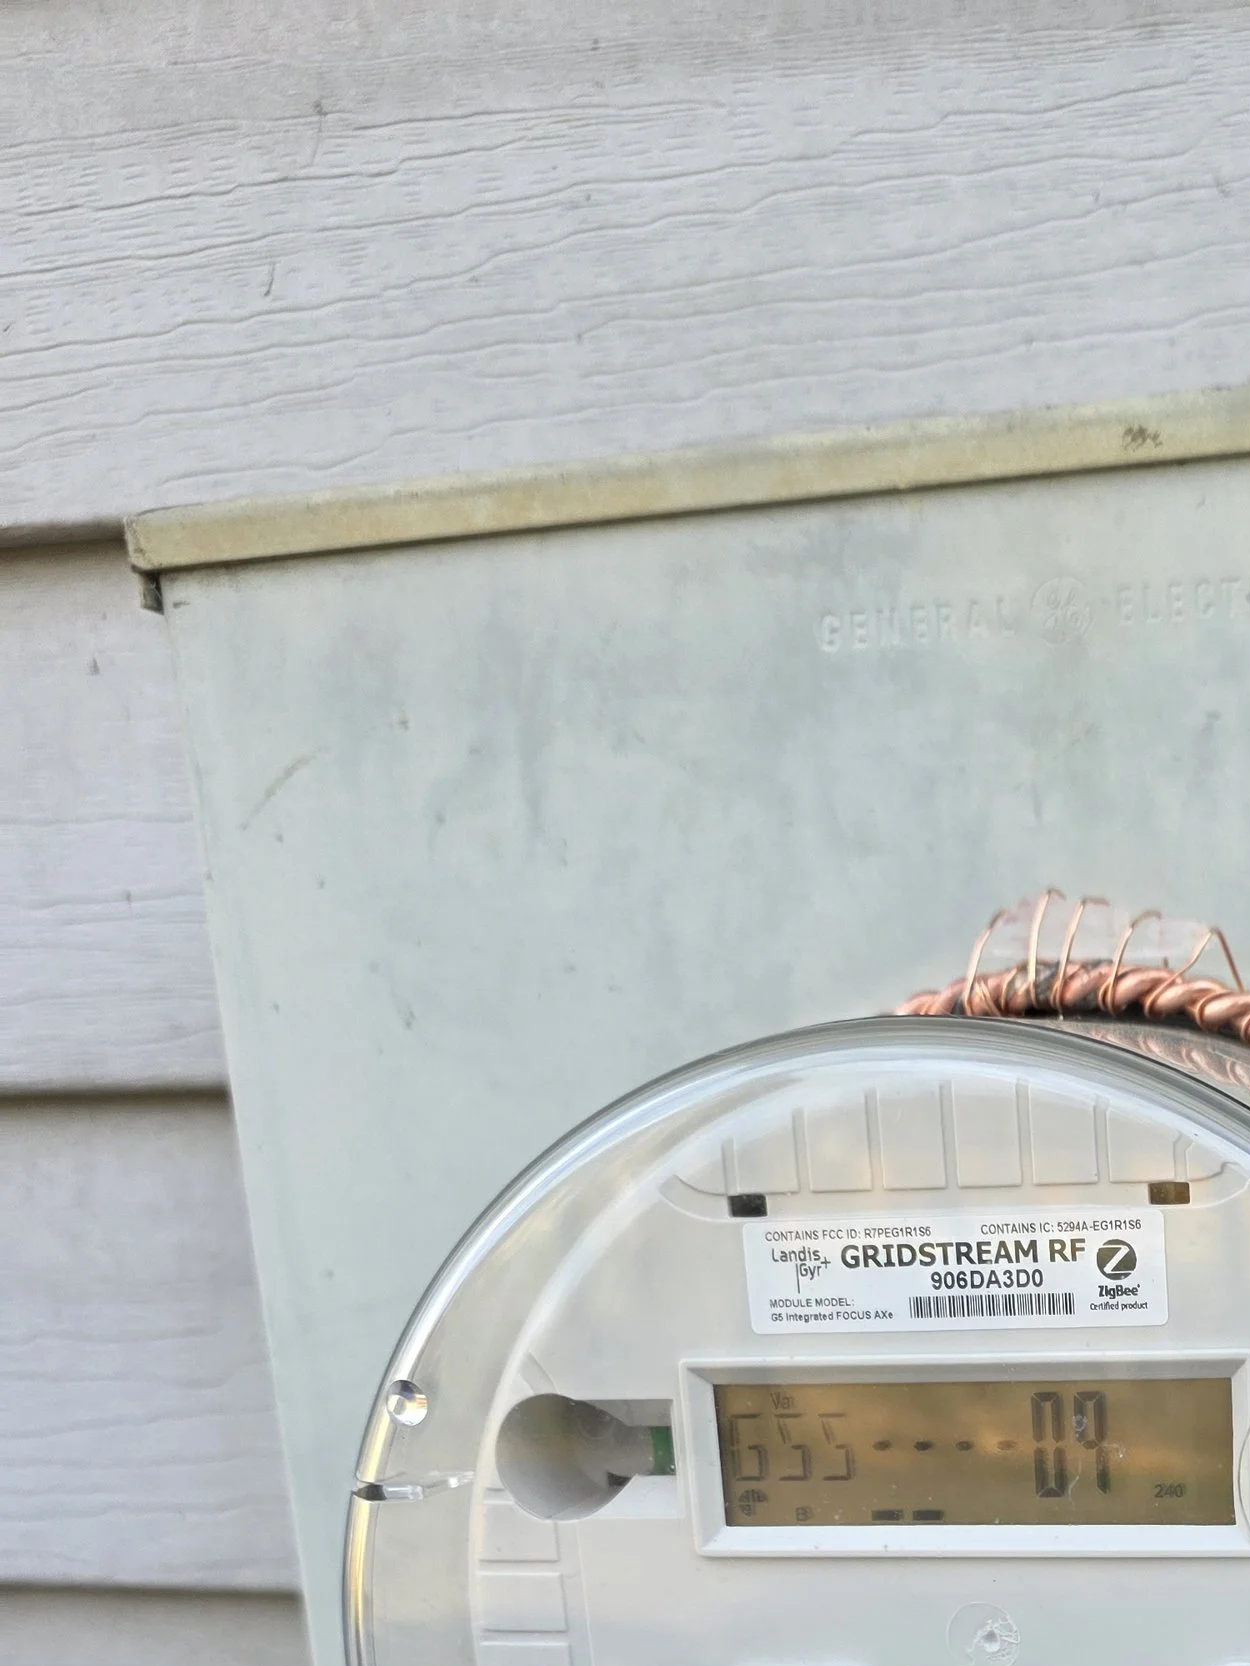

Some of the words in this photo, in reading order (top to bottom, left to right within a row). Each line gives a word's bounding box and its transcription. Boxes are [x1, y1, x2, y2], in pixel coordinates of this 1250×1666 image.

[819, 596, 1018, 654] GENERAL
[765, 1229, 819, 1243] CONTAINS
[822, 1229, 844, 1241] FCC
[846, 1229, 861, 1240] ID:
[864, 1226, 932, 1240] R7PEG1R1S6
[980, 1223, 1036, 1236] CONTAINS
[1039, 1222, 1055, 1234] IC:
[1057, 1219, 1142, 1233] 5294A-EG1R1S6
[840, 1239, 1039, 1269] GRIDSTREAM
[1048, 1238, 1086, 1264] RF
[930, 1268, 1044, 1291] 906DA3D0
[769, 1298, 813, 1309] MODULE
[814, 1297, 855, 1308] MODEL:
[1089, 1301, 1120, 1312] Certified
[1121, 1301, 1148, 1311] product
[771, 1312, 784, 1322] G5
[786, 1311, 834, 1323] Integrated
[836, 1310, 872, 1321] FOCUS
[873, 1309, 894, 1320] AXe
[1153, 1483, 1186, 1499] 240
